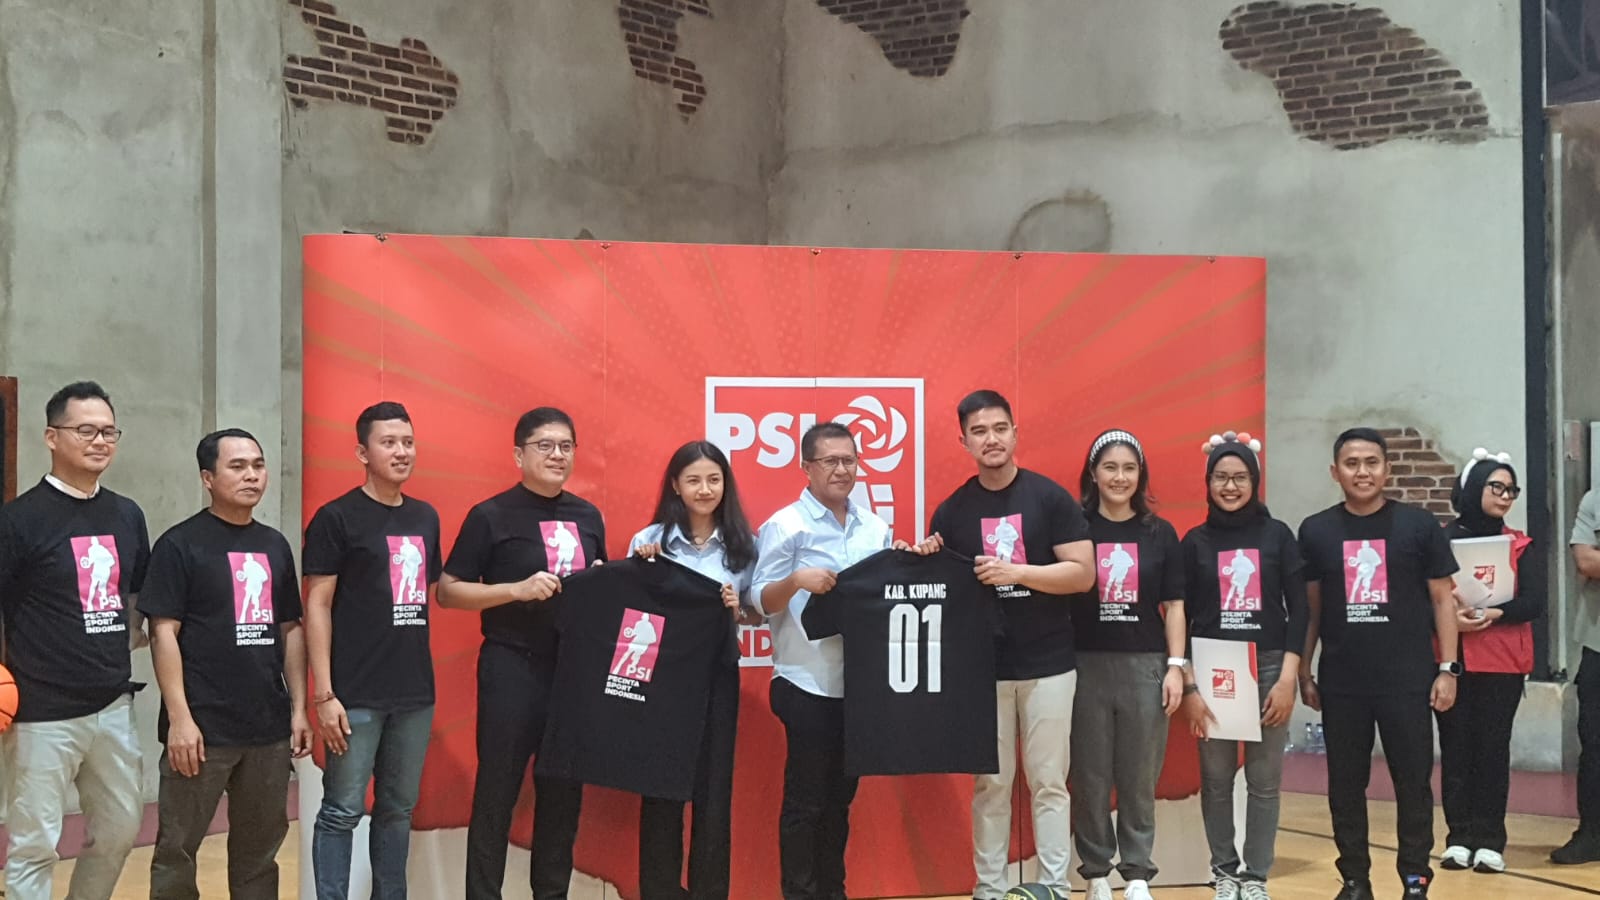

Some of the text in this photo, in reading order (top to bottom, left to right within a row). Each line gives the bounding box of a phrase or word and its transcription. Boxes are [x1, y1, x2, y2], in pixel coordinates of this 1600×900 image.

[408, 590, 426, 603] PSI
[884, 583, 947, 599] KAB. KUPANG
[997, 590, 1031, 598] ONESIA
[1114, 590, 1138, 602] PSI
[1360, 590, 1388, 602] PSI
[99, 594, 123, 610] PSI
[1235, 597, 1260, 610] PSI
[252, 608, 273, 622] PSI
[888, 603, 942, 692] 01
[626, 663, 651, 681] PSI
[607, 674, 640, 687] PECINTA
[604, 687, 646, 702] INDONESIA
